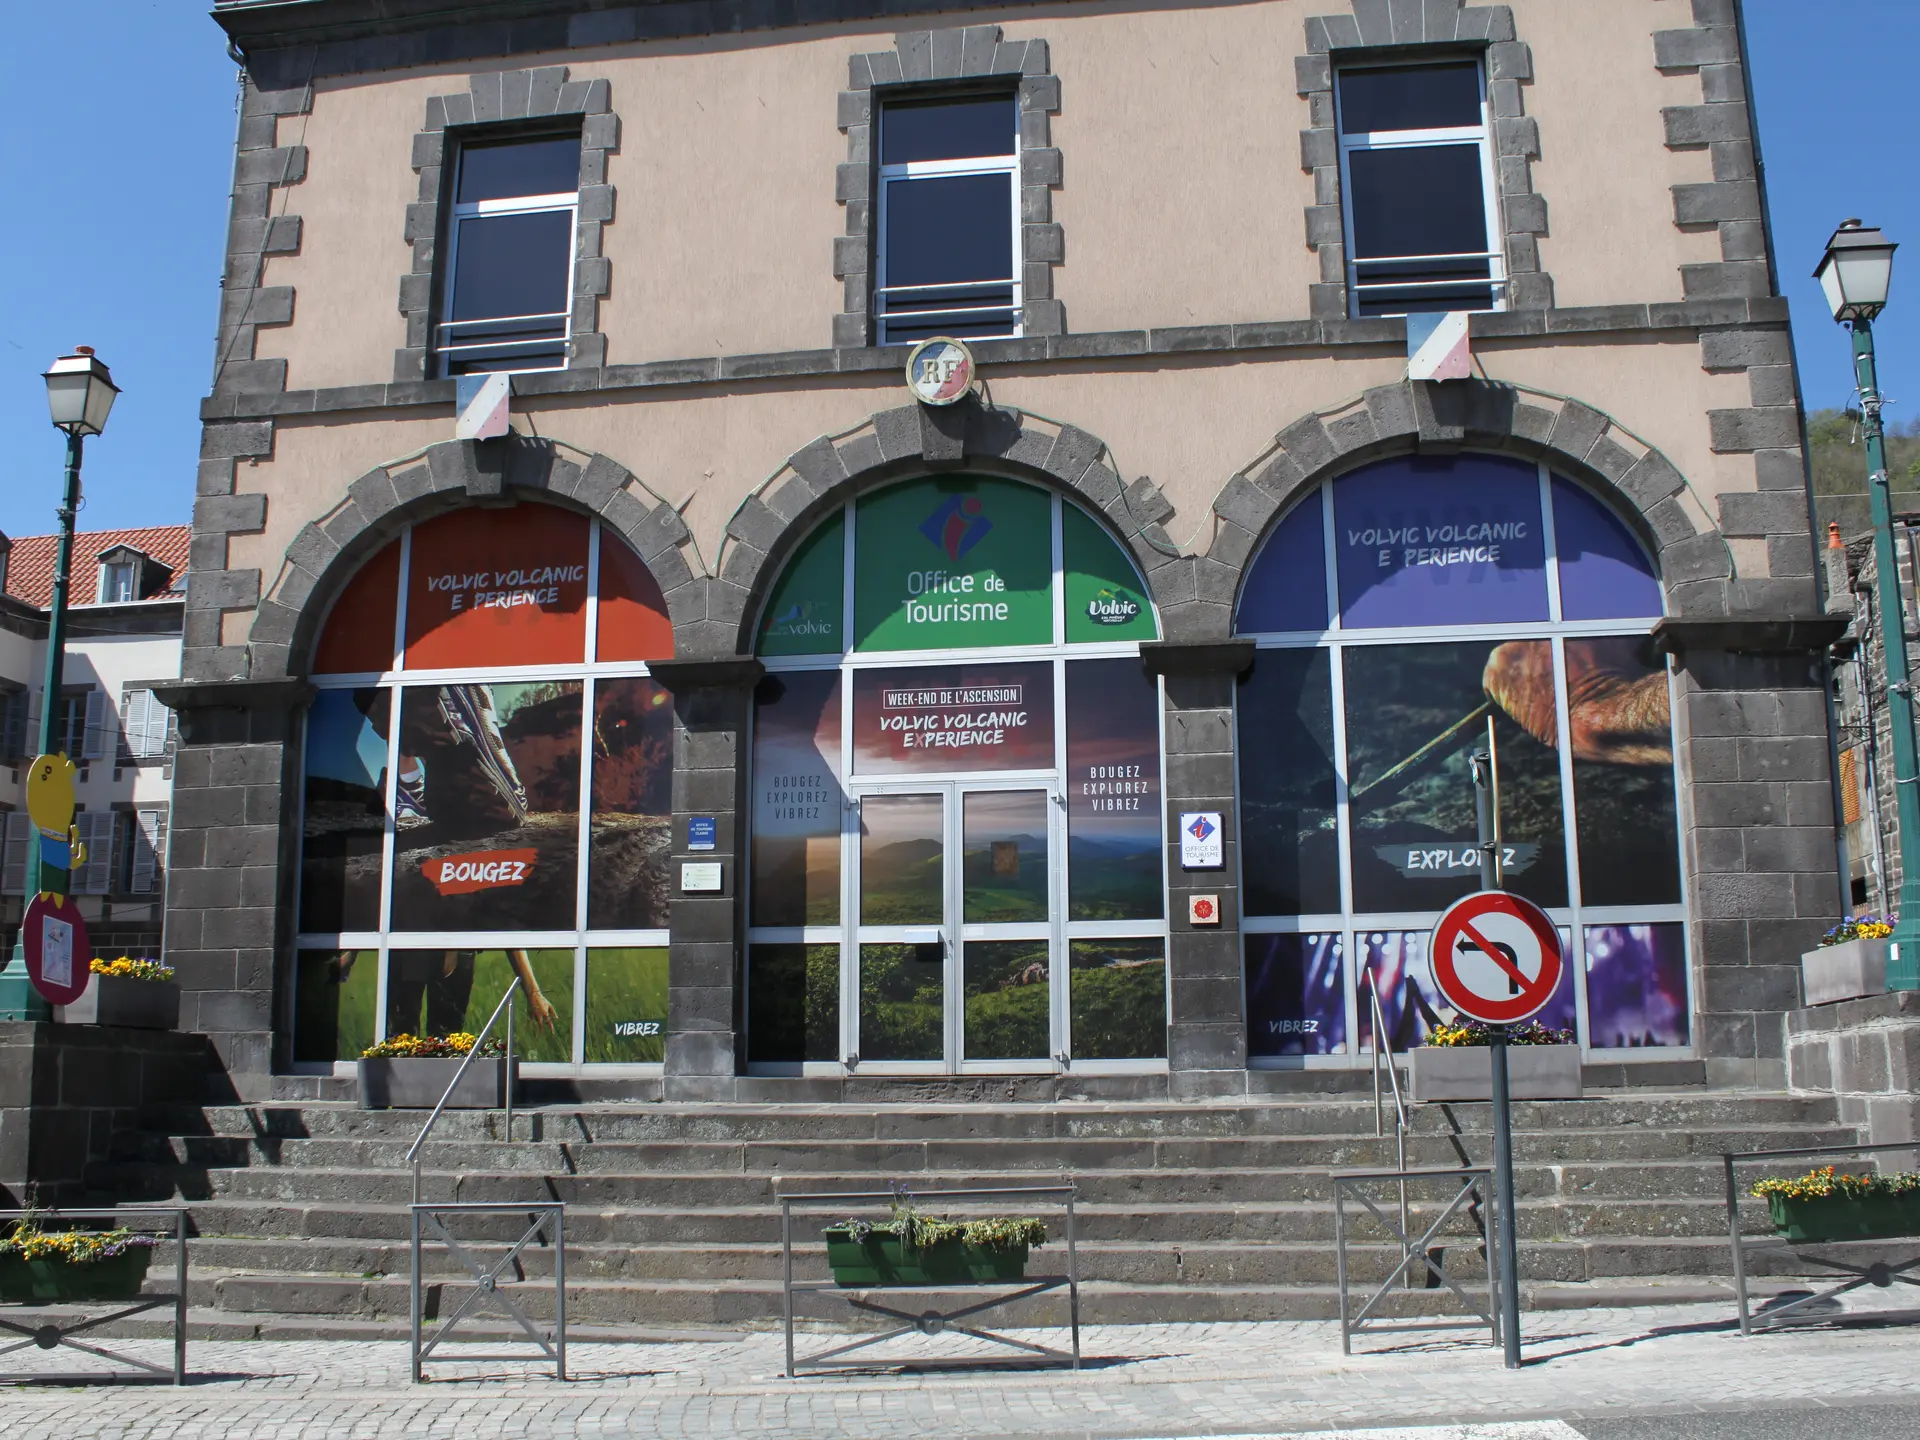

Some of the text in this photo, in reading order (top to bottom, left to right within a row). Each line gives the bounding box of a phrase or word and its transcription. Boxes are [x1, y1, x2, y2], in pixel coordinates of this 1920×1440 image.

[922, 359, 960, 384] RF
[1347, 521, 1528, 546] VOLVIC VOLCANIC
[1378, 544, 1501, 567] EPERIENCE
[428, 565, 585, 592] VOLVIC VOLCANIC
[908, 570, 1006, 595] Office de
[451, 587, 559, 610] EPERIENCE
[1089, 599, 1137, 615] Volvic
[901, 597, 1009, 625] Tourisme
[789, 619, 832, 635] volvic
[888, 688, 1018, 706] WEEK-END DE L'ASCENSION
[880, 711, 1028, 731] VOLVIC VOLCANIC
[903, 729, 1004, 748] EXPERIENCE
[1090, 765, 1140, 779] BOUGEZ
[774, 775, 821, 788] BOUGEZ
[1083, 781, 1148, 795] EXPLOREZ
[767, 791, 828, 804] EXPLOREZ
[1092, 798, 1139, 811] VIBREZ
[775, 807, 819, 819] VIBREZ
[1407, 848, 1516, 870] EXPLOZ
[440, 861, 526, 883] BOUGEZ
[614, 1022, 660, 1036] VIBREZ
[1269, 1020, 1319, 1034] VIBREZ
